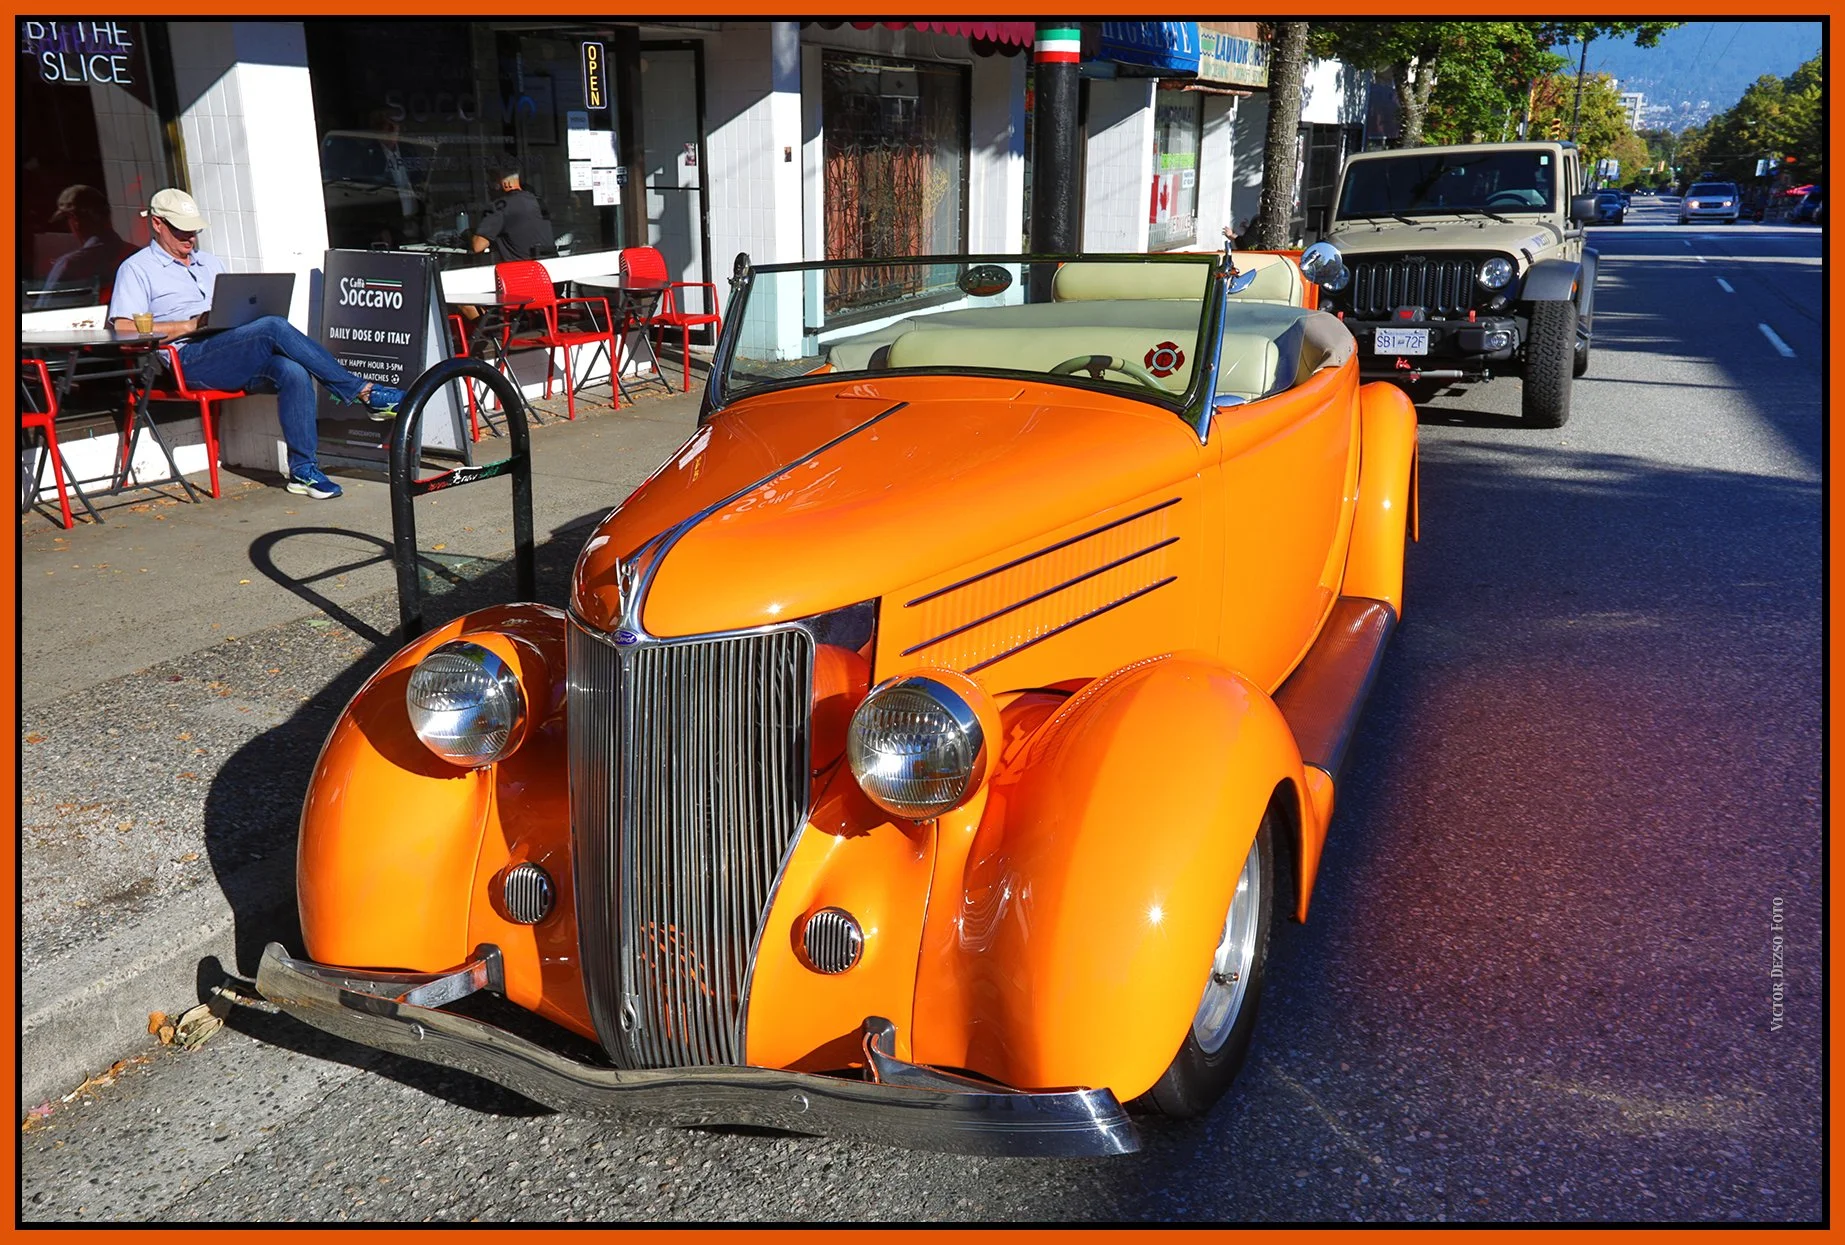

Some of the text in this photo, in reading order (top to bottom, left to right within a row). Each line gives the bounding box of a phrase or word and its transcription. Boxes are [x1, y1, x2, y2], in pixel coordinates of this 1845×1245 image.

[27, 22, 57, 41] BY
[77, 22, 133, 46] THE
[42, 51, 132, 84] SLICE
[588, 45, 600, 106] OPEN
[339, 277, 403, 309] Soccavo
[349, 277, 365, 289] Caffè
[329, 327, 411, 345] DAILY DOSE OF ITALY
[348, 359, 366, 368] HAPPY
[367, 361, 385, 370] HOUR
[386, 362, 403, 372] 3-5PM
[362, 372, 390, 382] MATCHES
